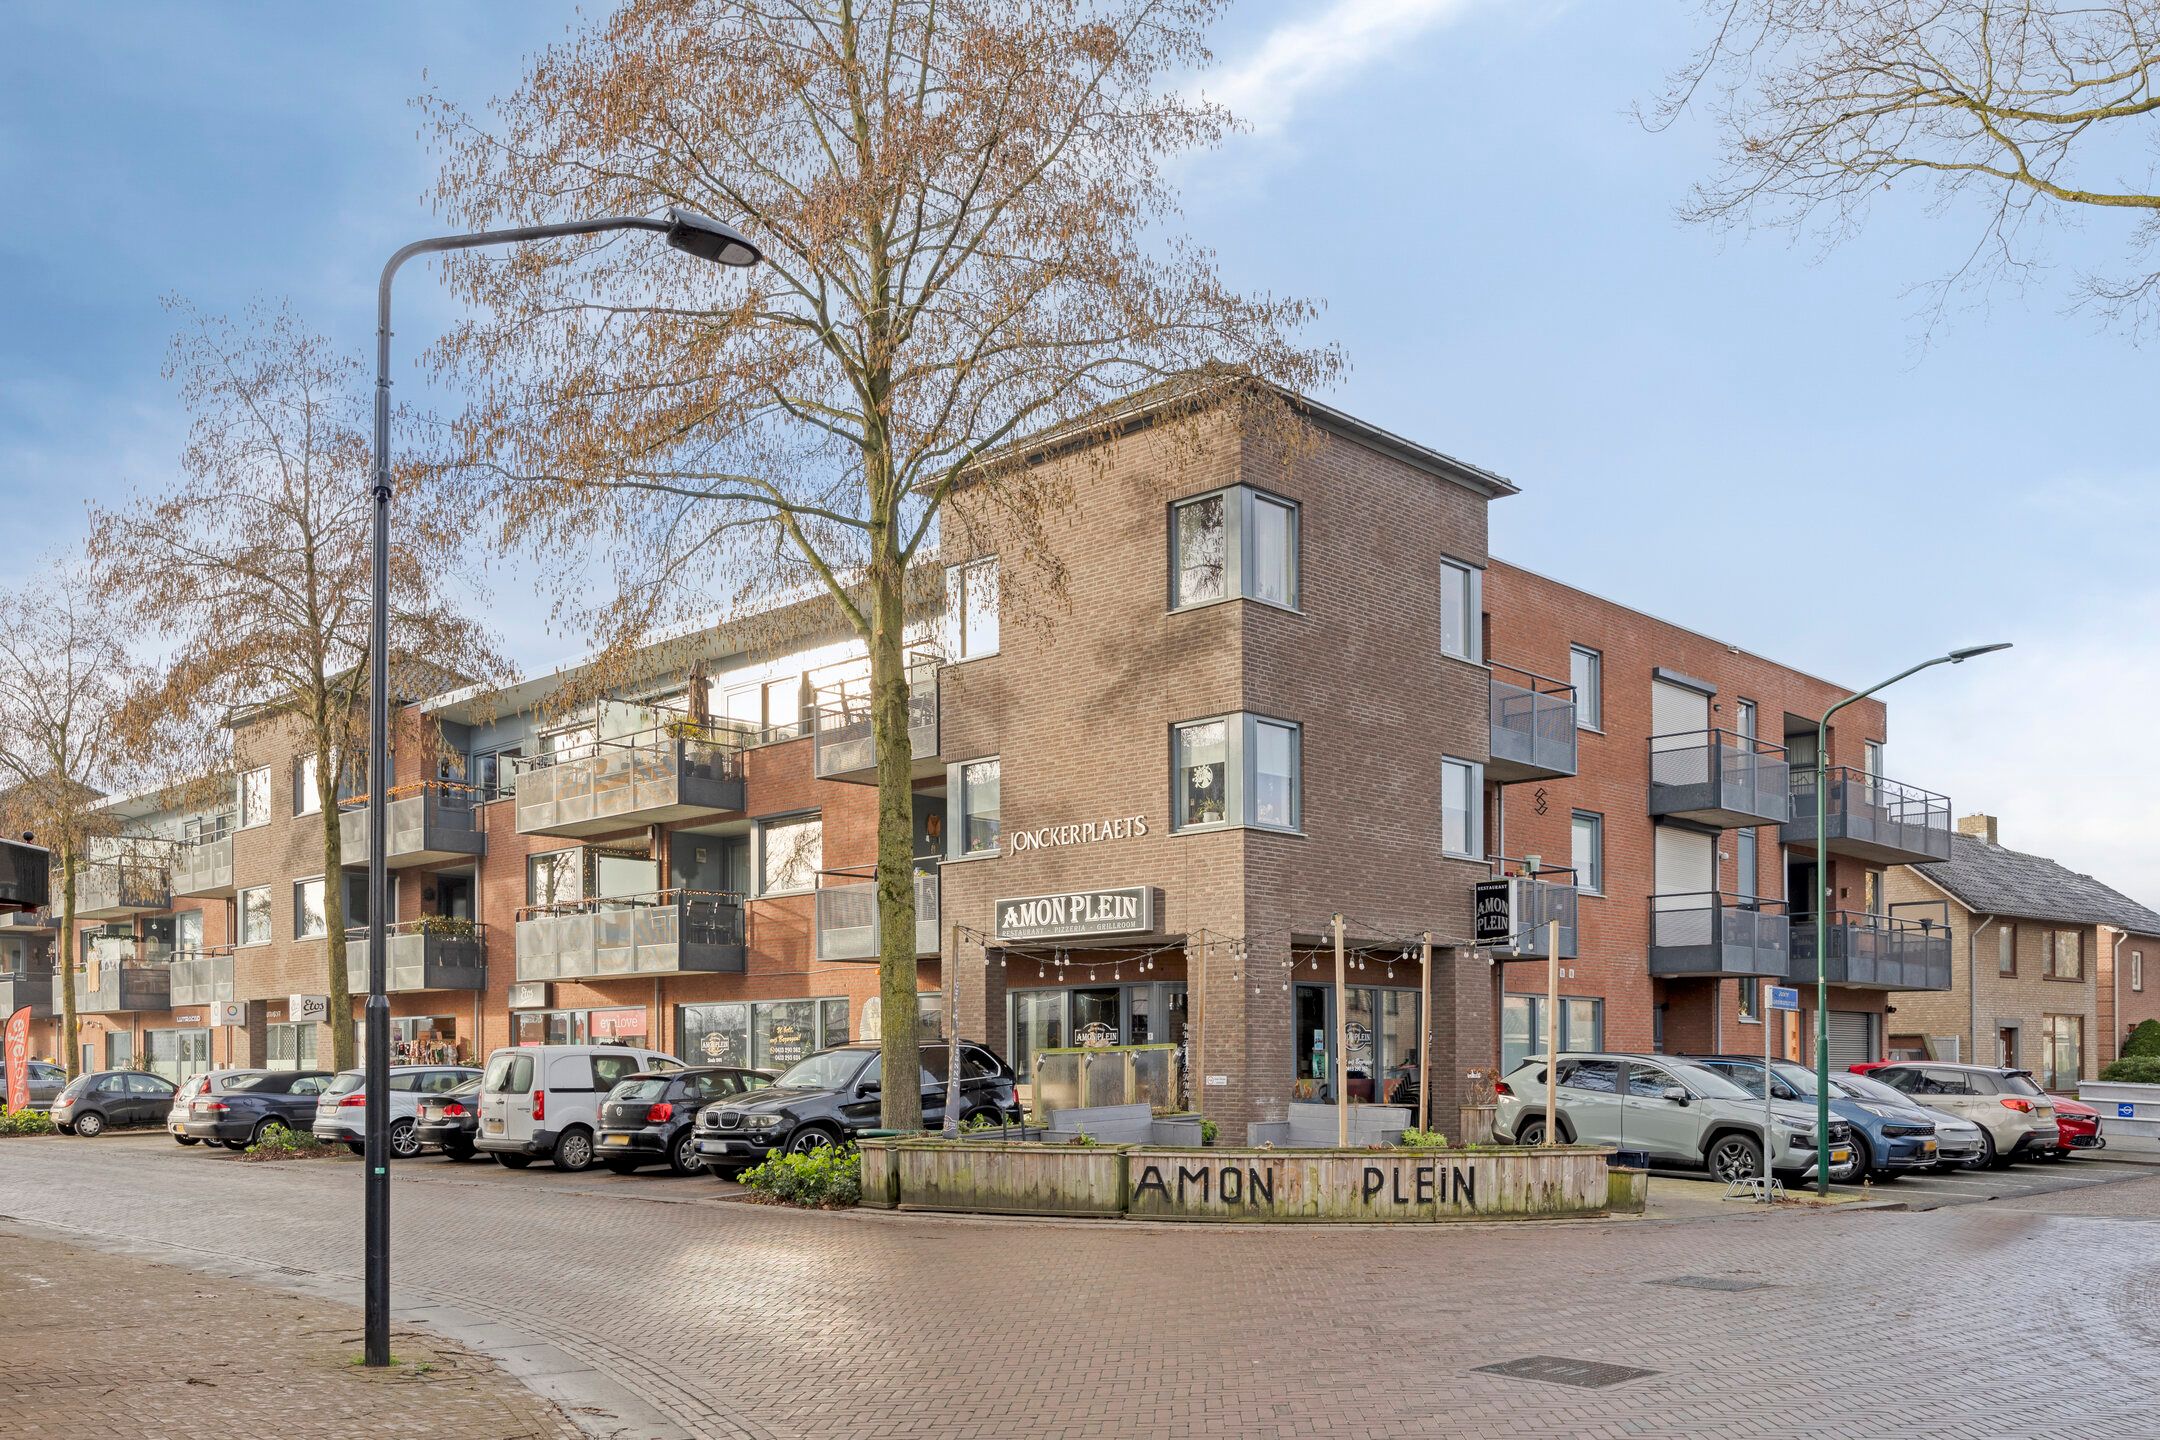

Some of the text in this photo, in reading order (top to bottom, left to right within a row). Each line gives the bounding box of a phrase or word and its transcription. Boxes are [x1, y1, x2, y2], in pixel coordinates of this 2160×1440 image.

[1010, 815, 1148, 856] JONCKERPLAETS
[1002, 895, 1138, 928] AMON PLEIN
[1477, 897, 1509, 917] AMON
[1002, 928, 1044, 937] RESTAURANT
[1054, 925, 1086, 933] PIZZERIA
[1096, 921, 1136, 930] GRILLROOM
[1477, 915, 1509, 931] PLEIN
[520, 986, 534, 1001] Etos
[303, 999, 325, 1013] Etos
[1133, 1165, 1274, 1204] AMON
